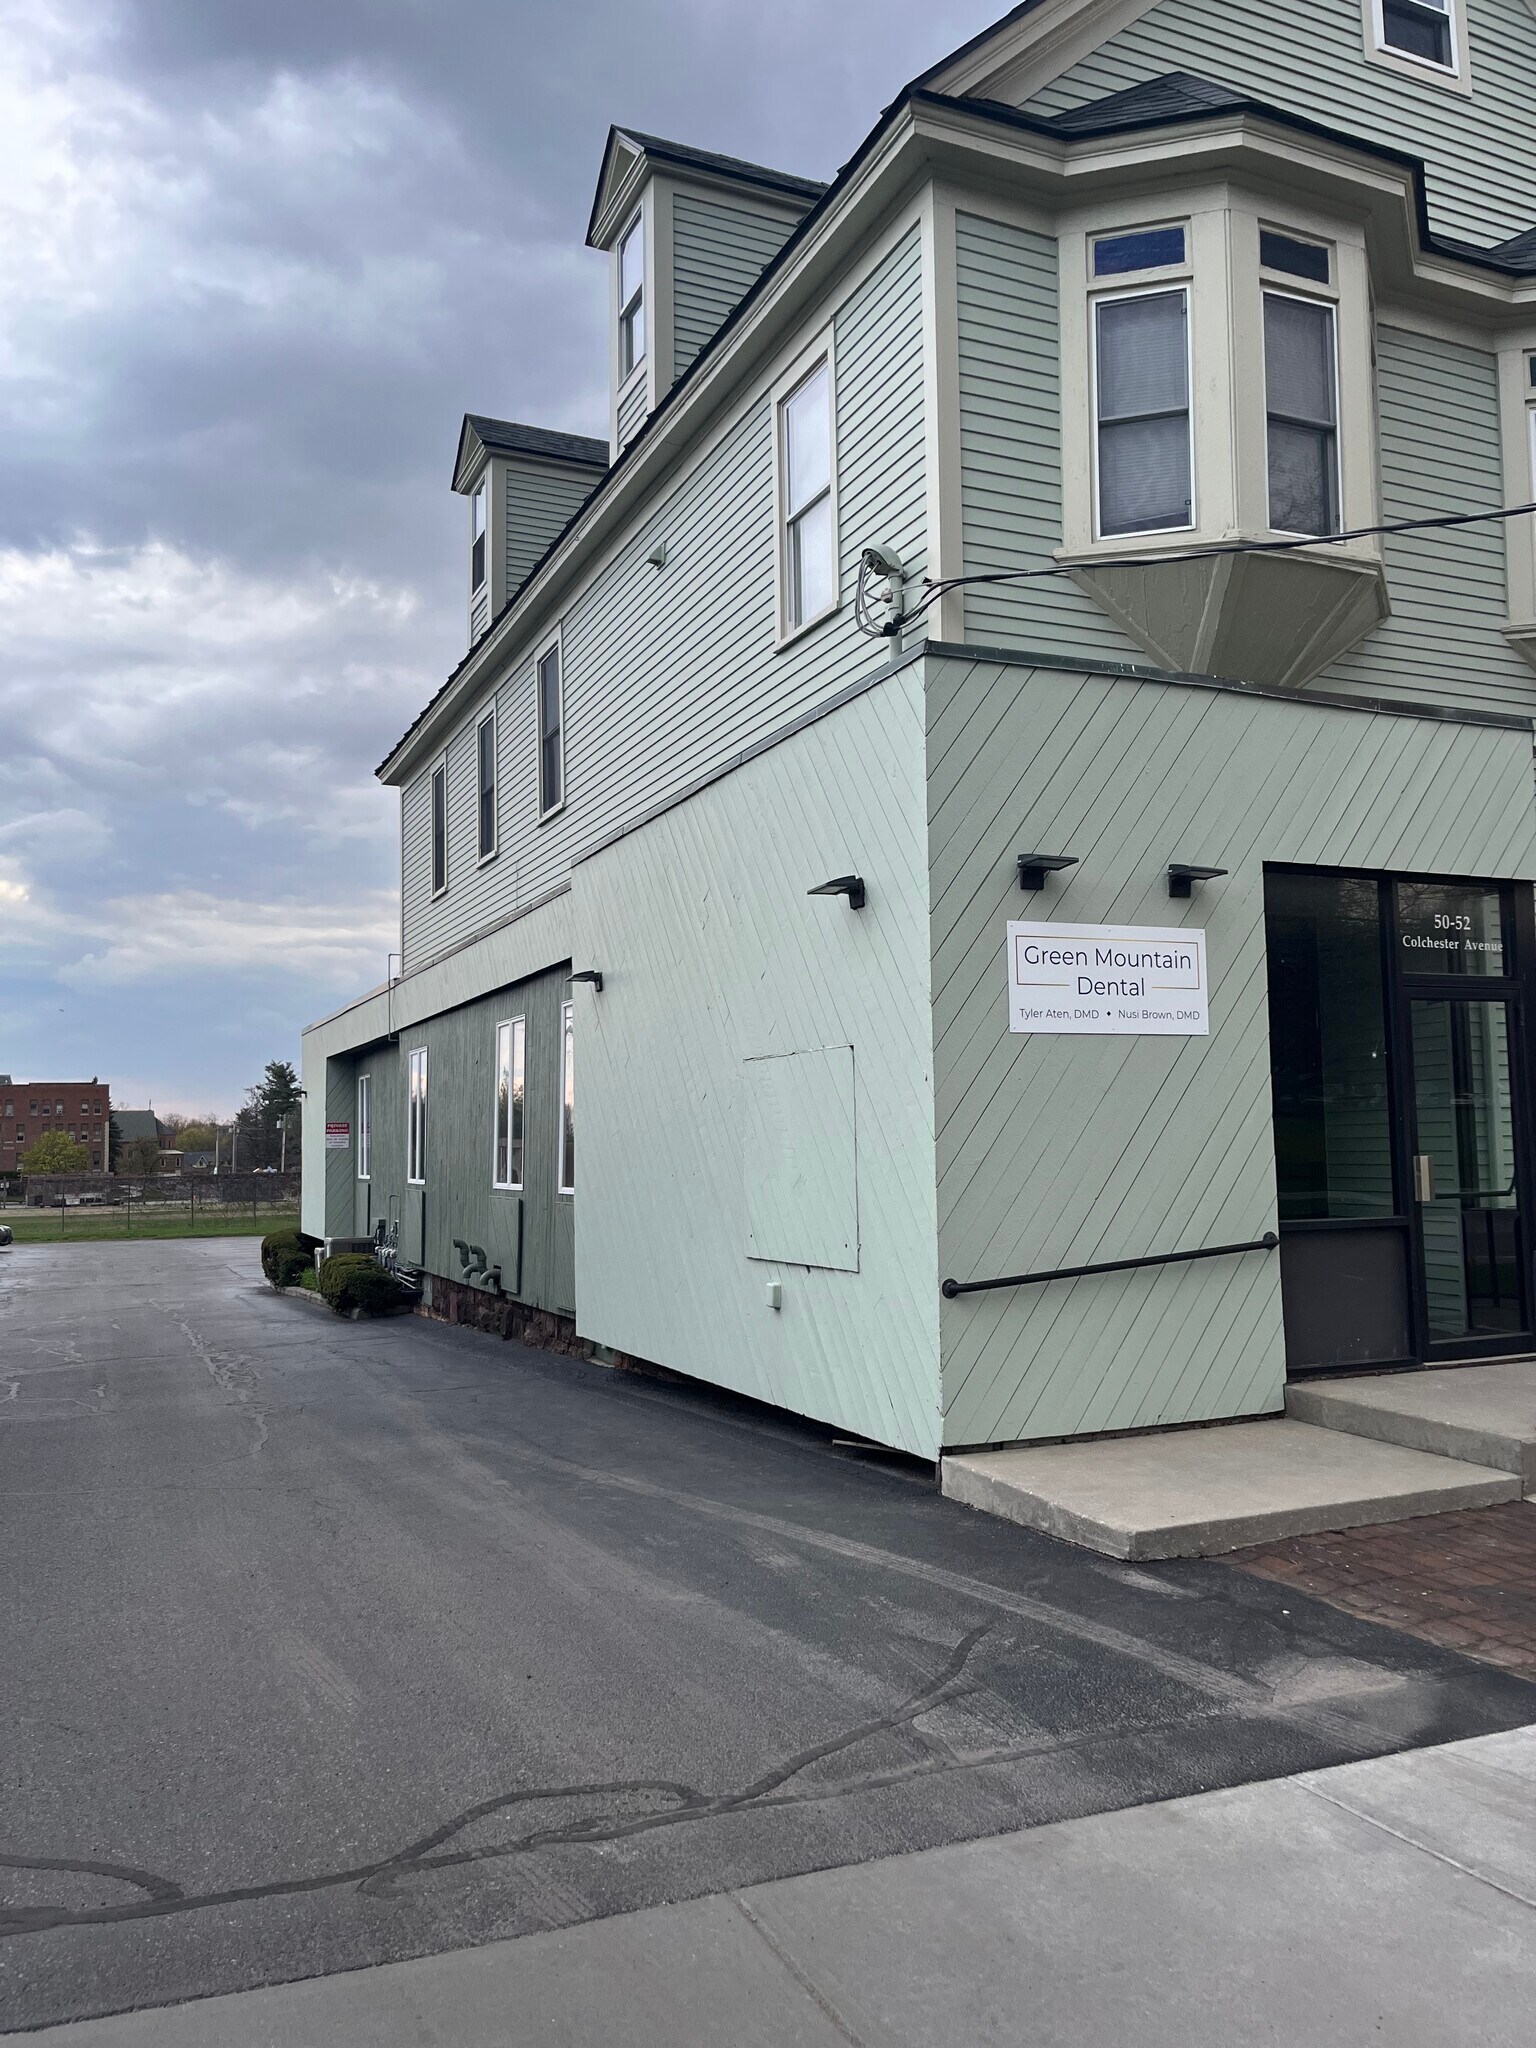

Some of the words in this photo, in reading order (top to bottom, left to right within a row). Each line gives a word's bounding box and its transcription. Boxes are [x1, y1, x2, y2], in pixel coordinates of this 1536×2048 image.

[1434, 914, 1471, 930] 50-52
[1402, 935, 1459, 950] Colchester
[1464, 939, 1504, 952] Avenue
[1024, 945, 1088, 966] Green
[1095, 948, 1191, 970] Mountain
[1077, 976, 1145, 997] Dental
[1019, 1008, 1043, 1020] Tyler
[1045, 1009, 1072, 1020] Aten,
[1074, 1009, 1100, 1019] DMD
[1118, 1009, 1139, 1019] Nusi
[1141, 1009, 1175, 1020] Brown,
[1176, 1010, 1200, 1020] DMD
